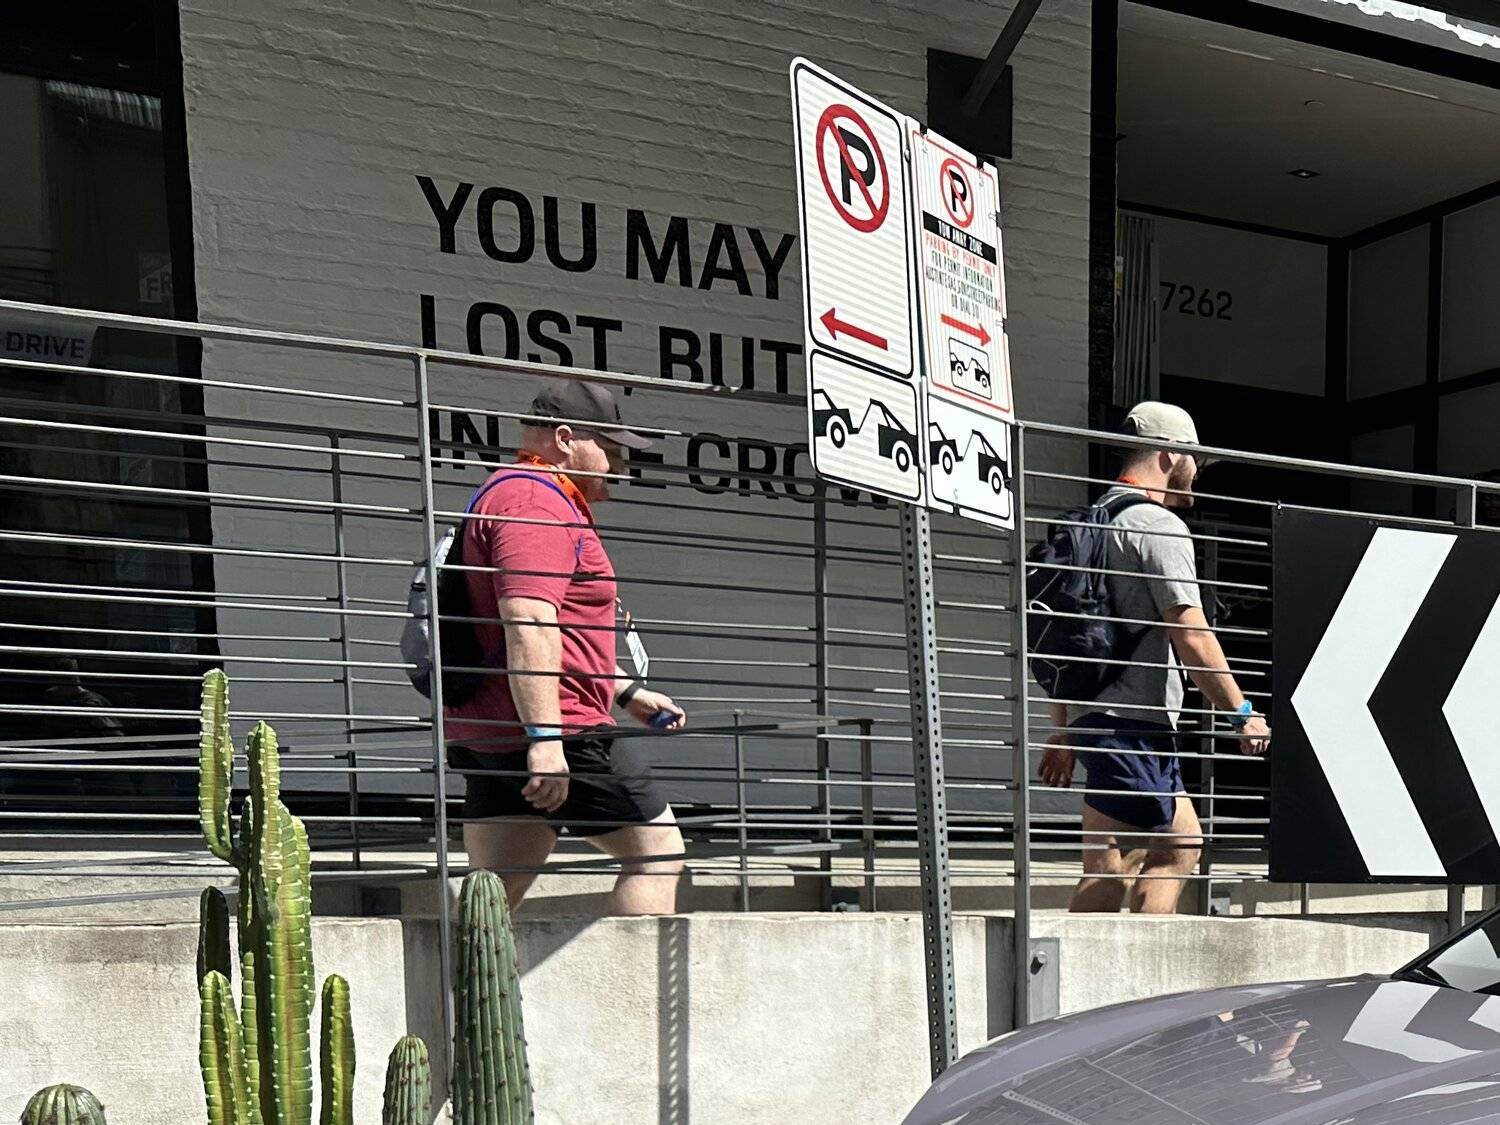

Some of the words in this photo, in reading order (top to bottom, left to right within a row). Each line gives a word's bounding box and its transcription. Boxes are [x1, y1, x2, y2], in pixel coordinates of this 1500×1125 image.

[415, 174, 597, 273] YOU
[625, 208, 797, 300] MAY
[1160, 281, 1233, 321] 7262
[5, 330, 88, 360] DRIVE
[659, 325, 803, 395] BUT
